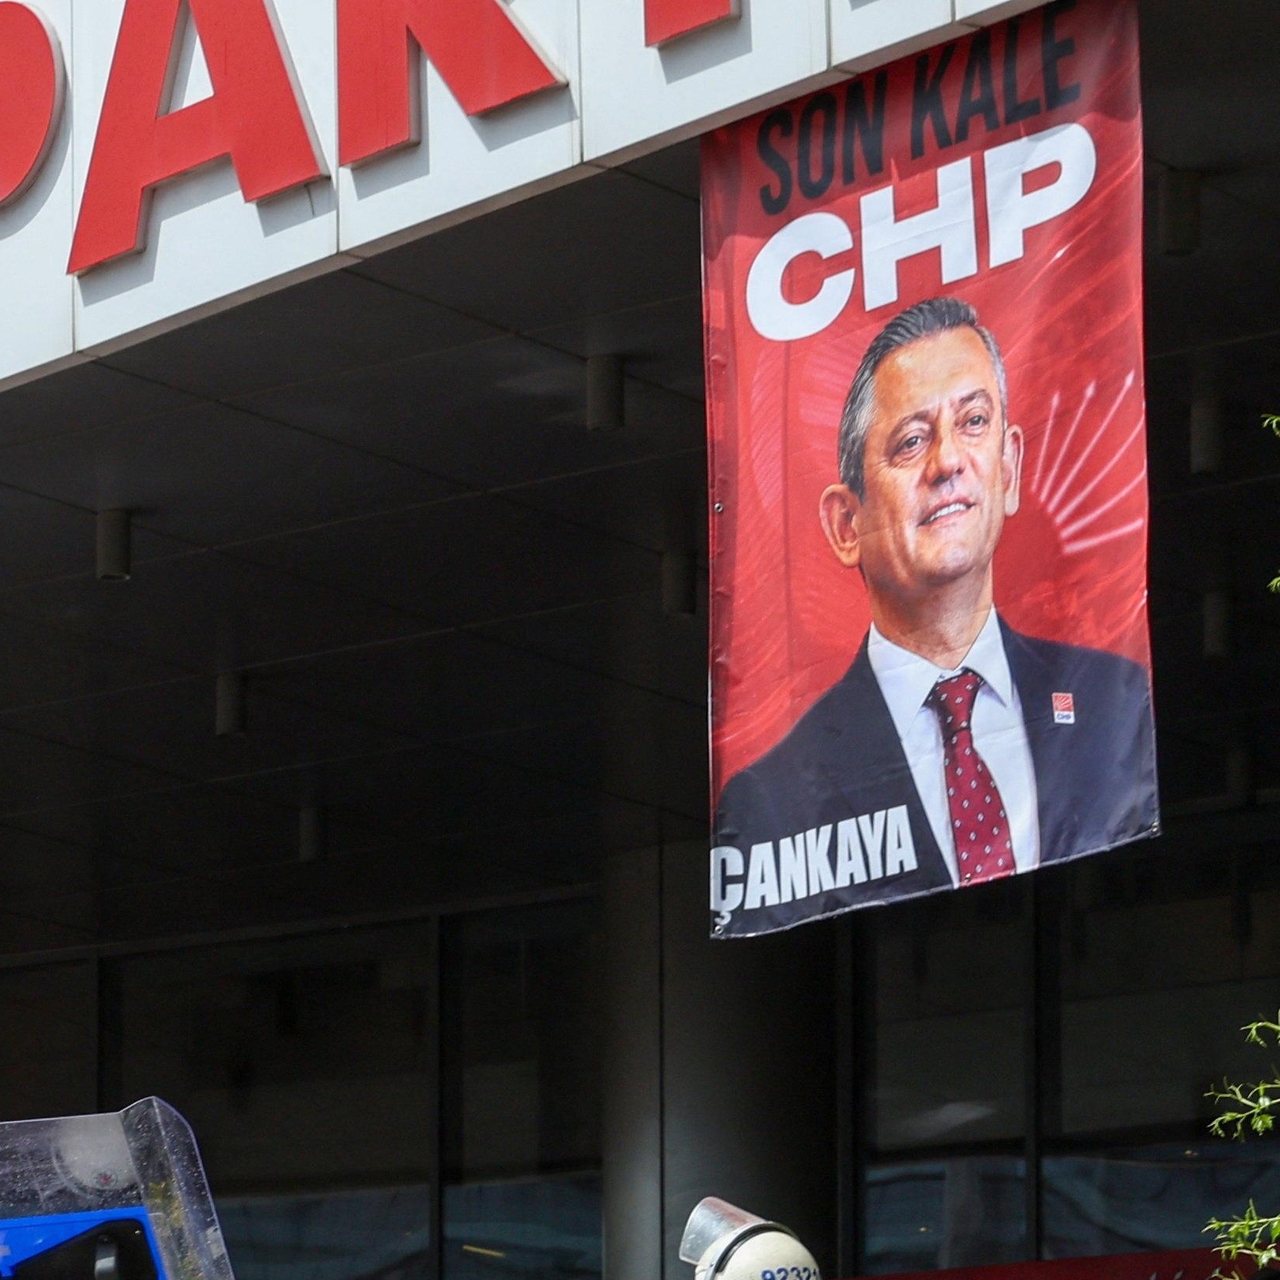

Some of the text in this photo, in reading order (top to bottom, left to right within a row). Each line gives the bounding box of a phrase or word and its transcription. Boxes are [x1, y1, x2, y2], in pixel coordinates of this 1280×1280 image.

[757, 5, 1082, 216] SON KALE
[746, 122, 1097, 341] CHP
[710, 804, 919, 925] ÇANKAYA
